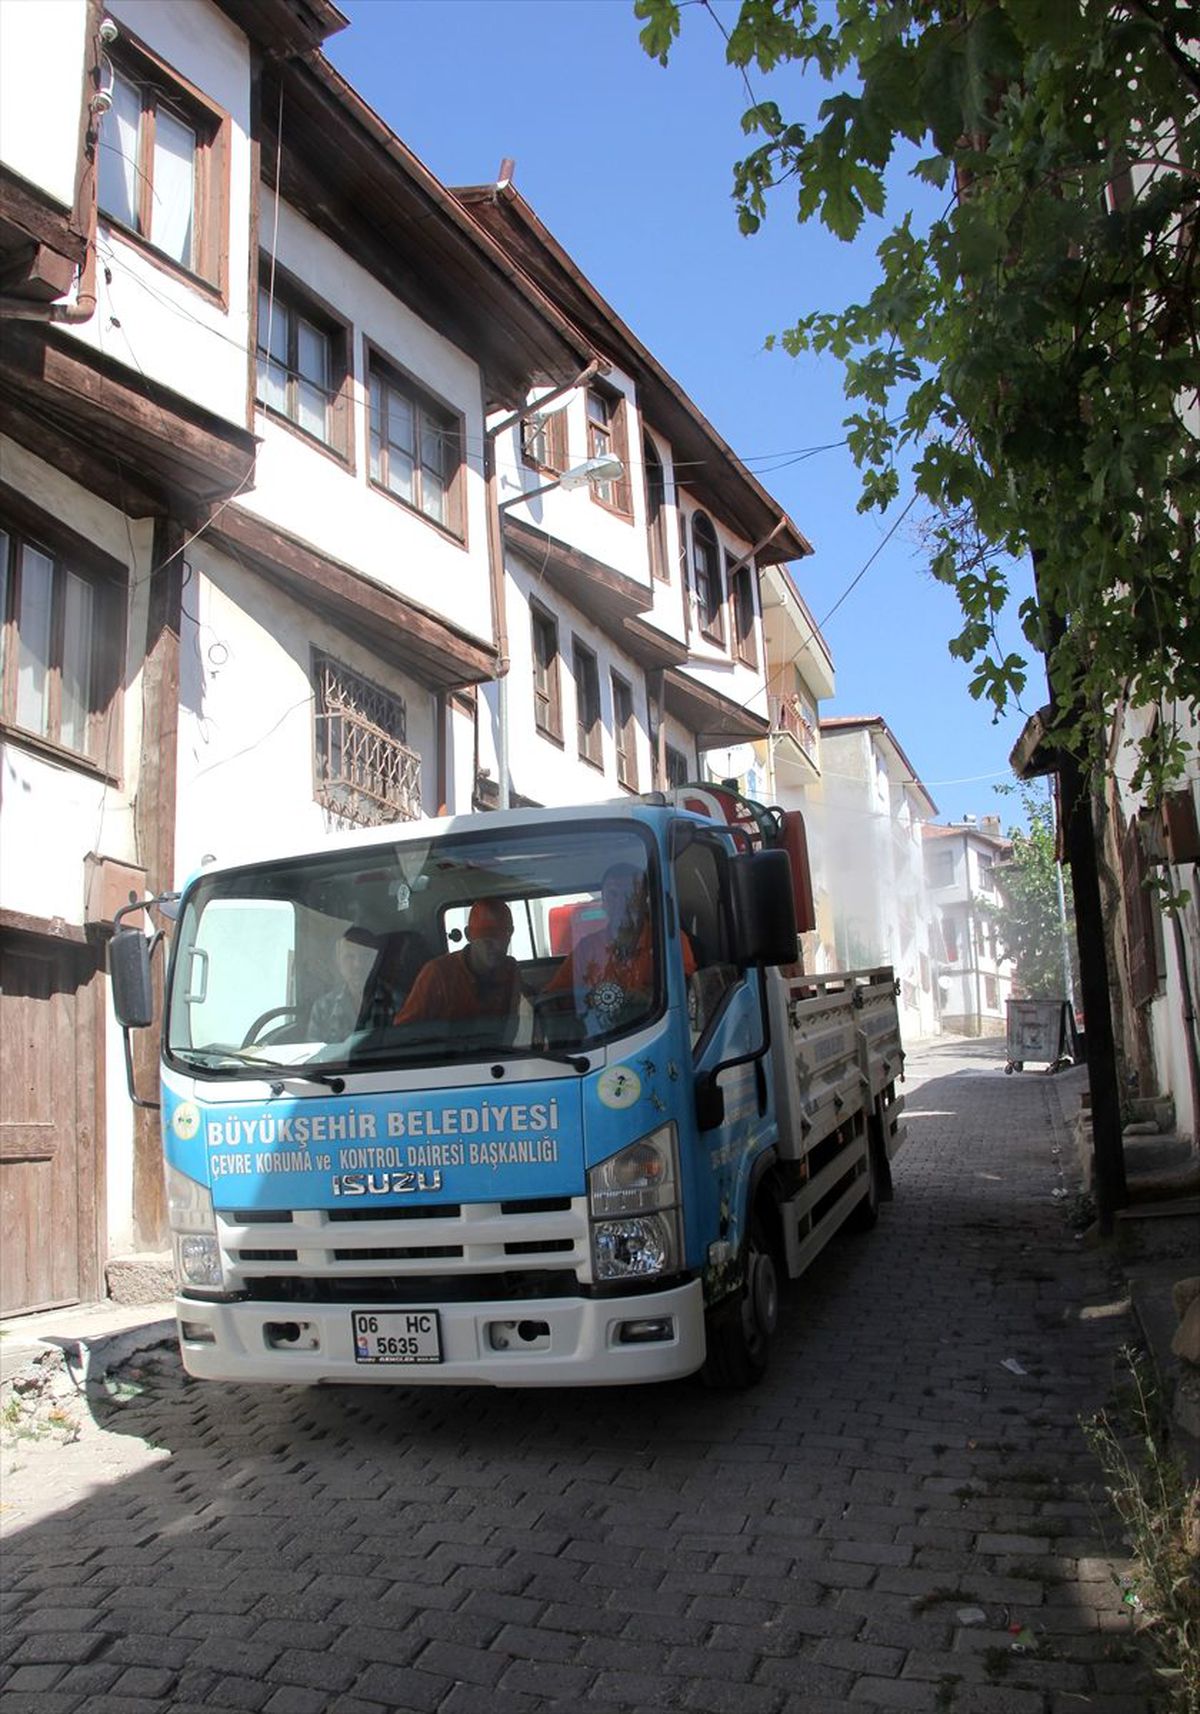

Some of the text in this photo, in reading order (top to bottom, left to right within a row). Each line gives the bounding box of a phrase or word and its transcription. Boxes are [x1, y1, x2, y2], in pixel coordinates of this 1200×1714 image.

[207, 1098, 558, 1149] BÜYÜKŞEHİR BELEDİYESİ
[210, 1136, 558, 1181] ÇEVRE KORUMA ve KONTROL DAİRESİ BAŞKANLIĞI
[333, 1170, 442, 1196] ISUZU
[358, 1316, 431, 1334] 06 HC
[376, 1337, 418, 1354] 5635
